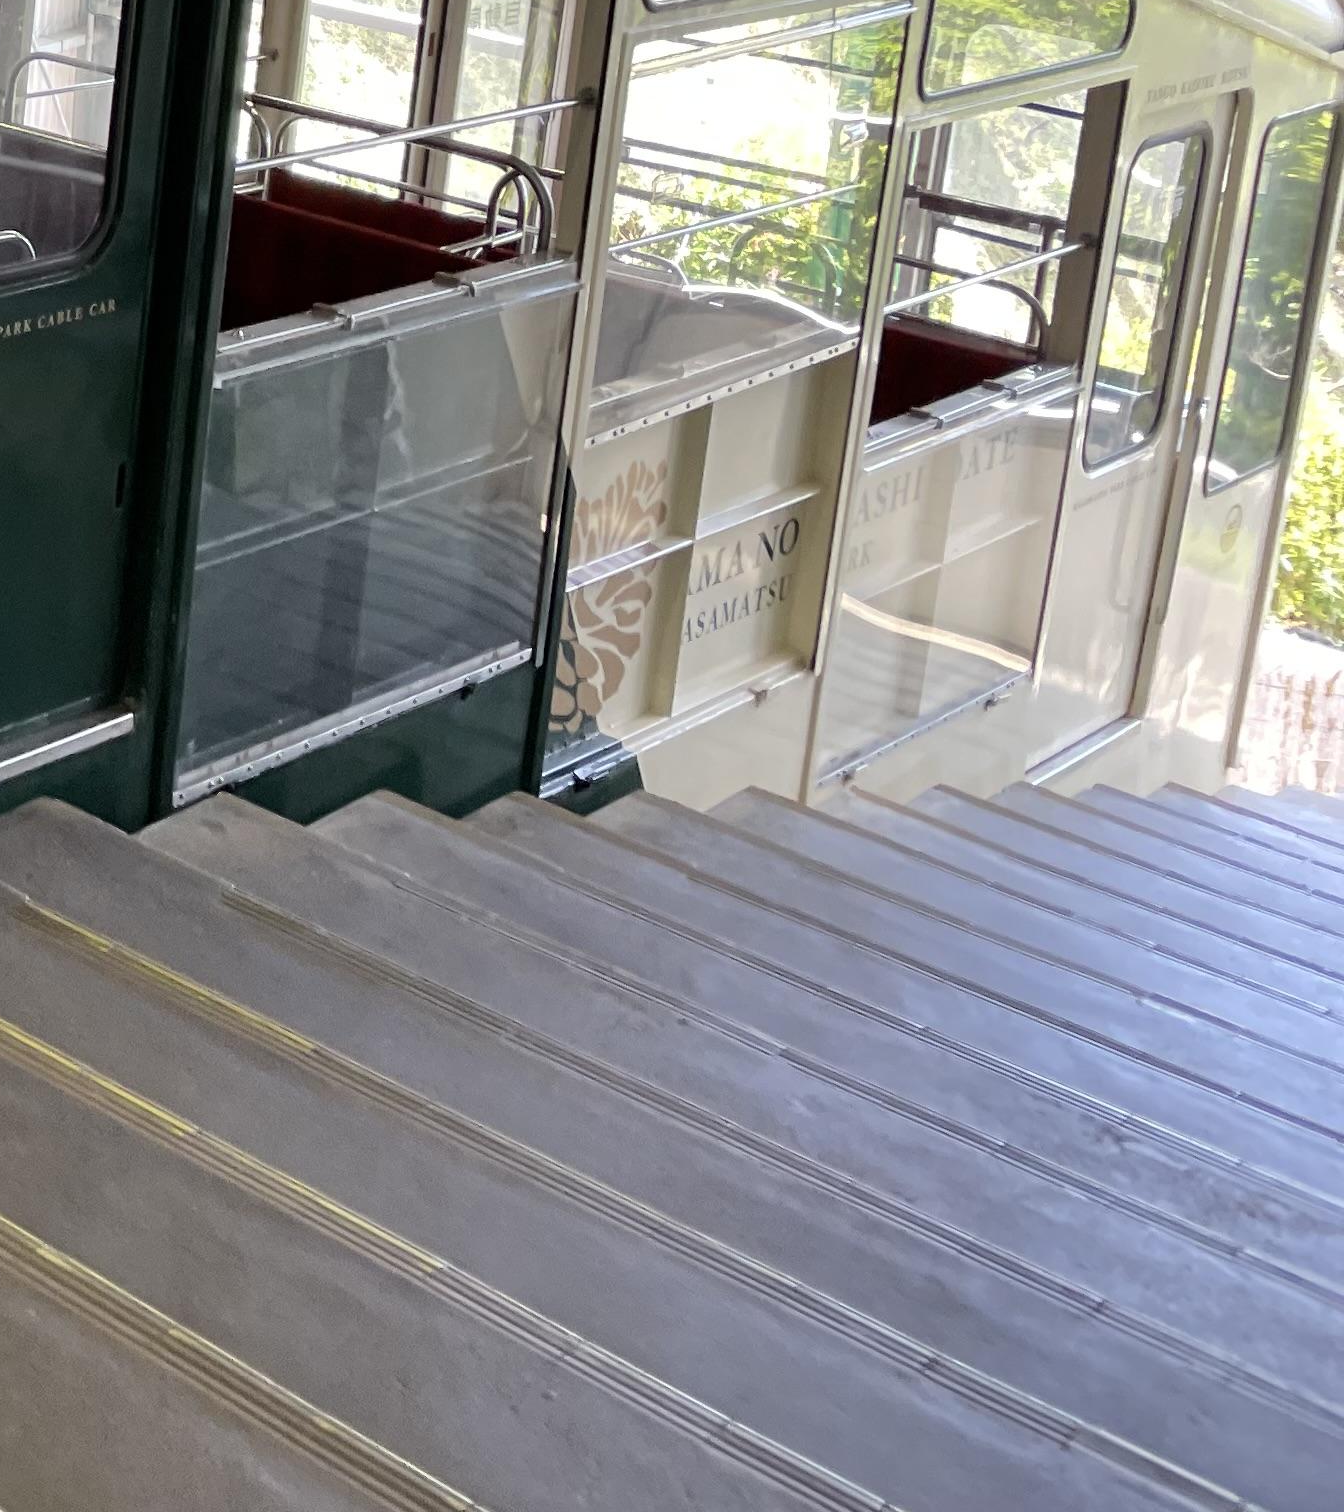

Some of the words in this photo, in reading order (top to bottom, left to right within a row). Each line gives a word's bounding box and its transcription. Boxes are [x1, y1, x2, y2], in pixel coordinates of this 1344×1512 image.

[37, 306, 83, 329] CABLE
[88, 298, 117, 317] CAR
[752, 518, 800, 568] NO
[683, 573, 793, 642] ASAMATSU
